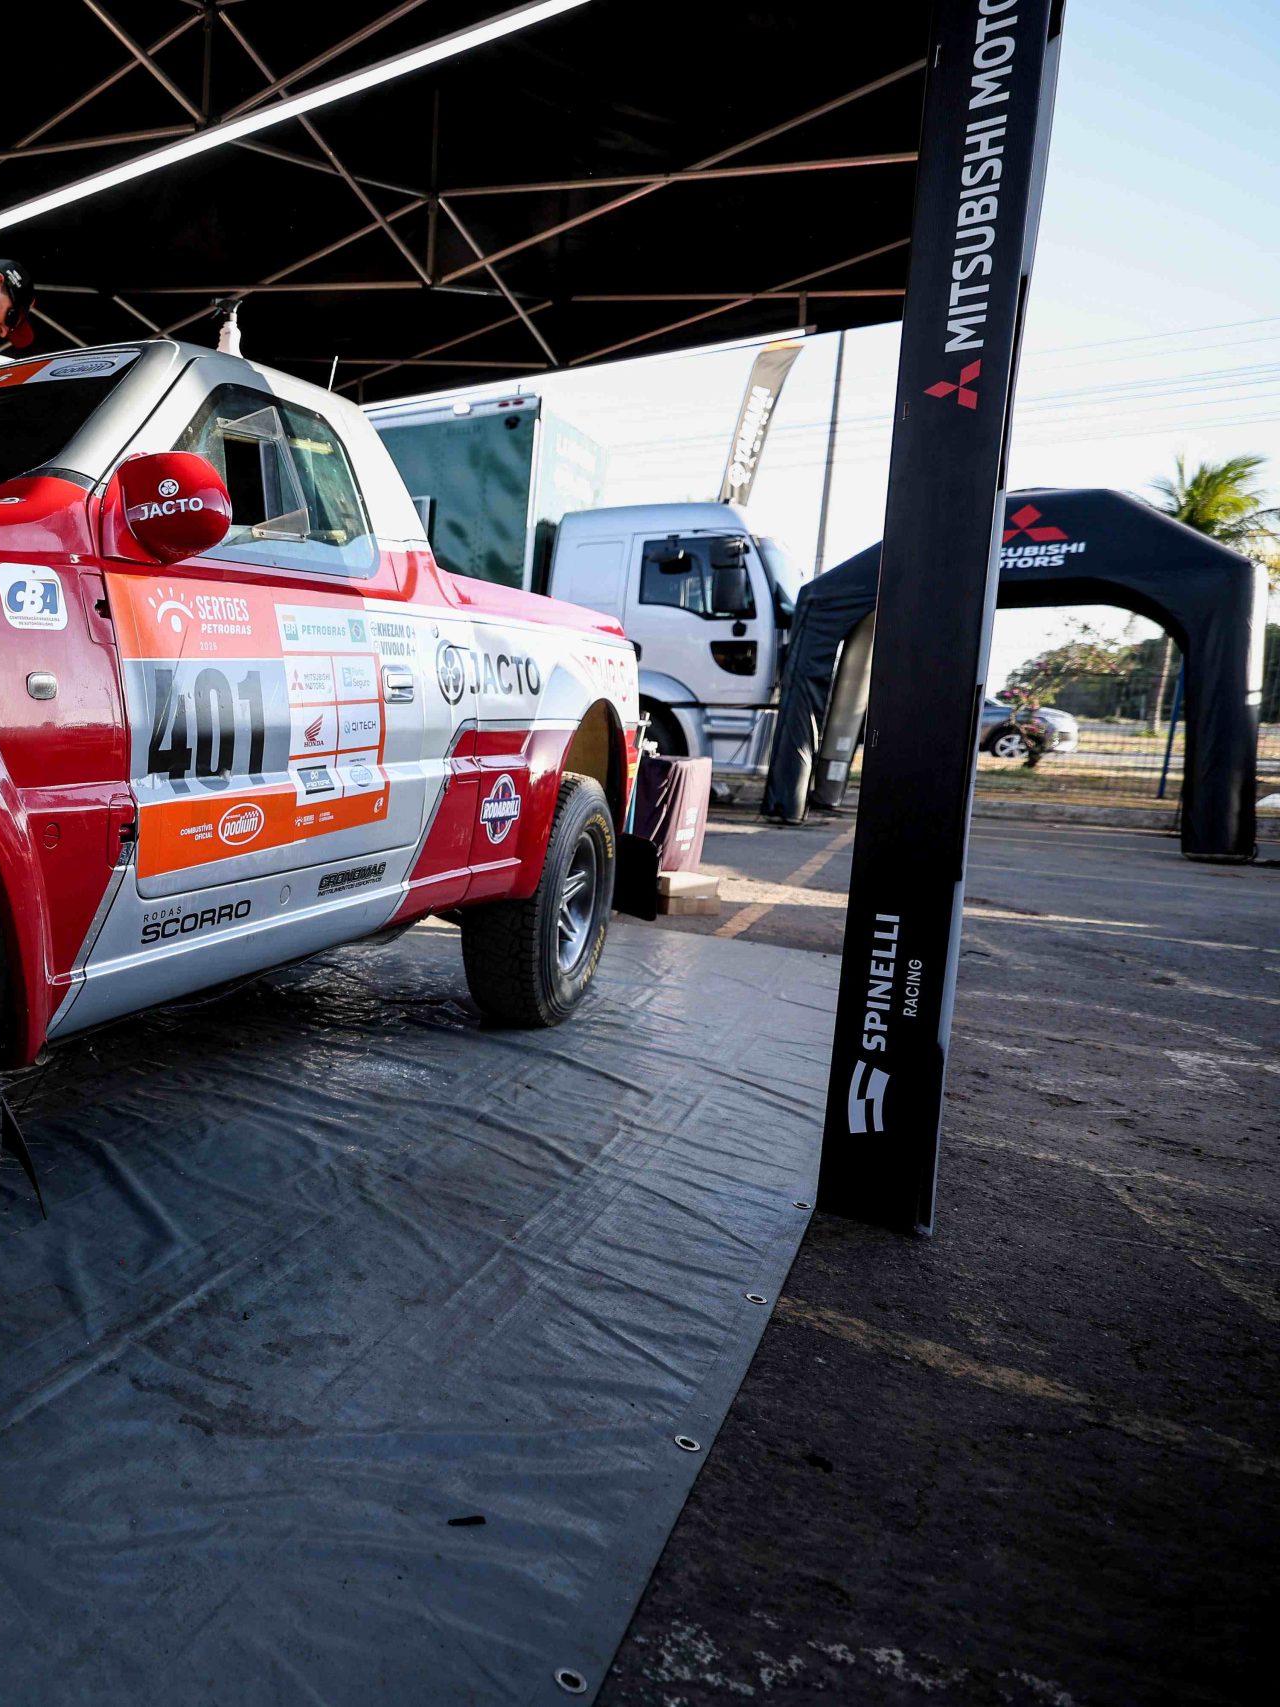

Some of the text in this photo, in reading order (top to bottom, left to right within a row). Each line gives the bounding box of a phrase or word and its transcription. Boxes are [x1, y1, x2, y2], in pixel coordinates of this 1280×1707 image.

[945, 114, 1008, 353] MITSUBISHI
[140, 497, 204, 521] JACTO
[7, 579, 59, 614] CBA
[201, 623, 252, 636] PETROBRAS
[302, 624, 346, 637] PETROBRAS
[377, 623, 405, 638] KHEZAM
[381, 641, 405, 656] VIVOLO
[470, 653, 541, 696] JACTO
[147, 667, 266, 795] 401
[180, 822, 213, 836] COMBUSTÍVEL
[194, 831, 213, 841] OFICIAL
[223, 815, 259, 839] podium
[141, 900, 251, 944] SCORRO
[143, 906, 182, 922] RODAS
[862, 913, 900, 1052] SPINELLI
[903, 959, 923, 1017] RACING
